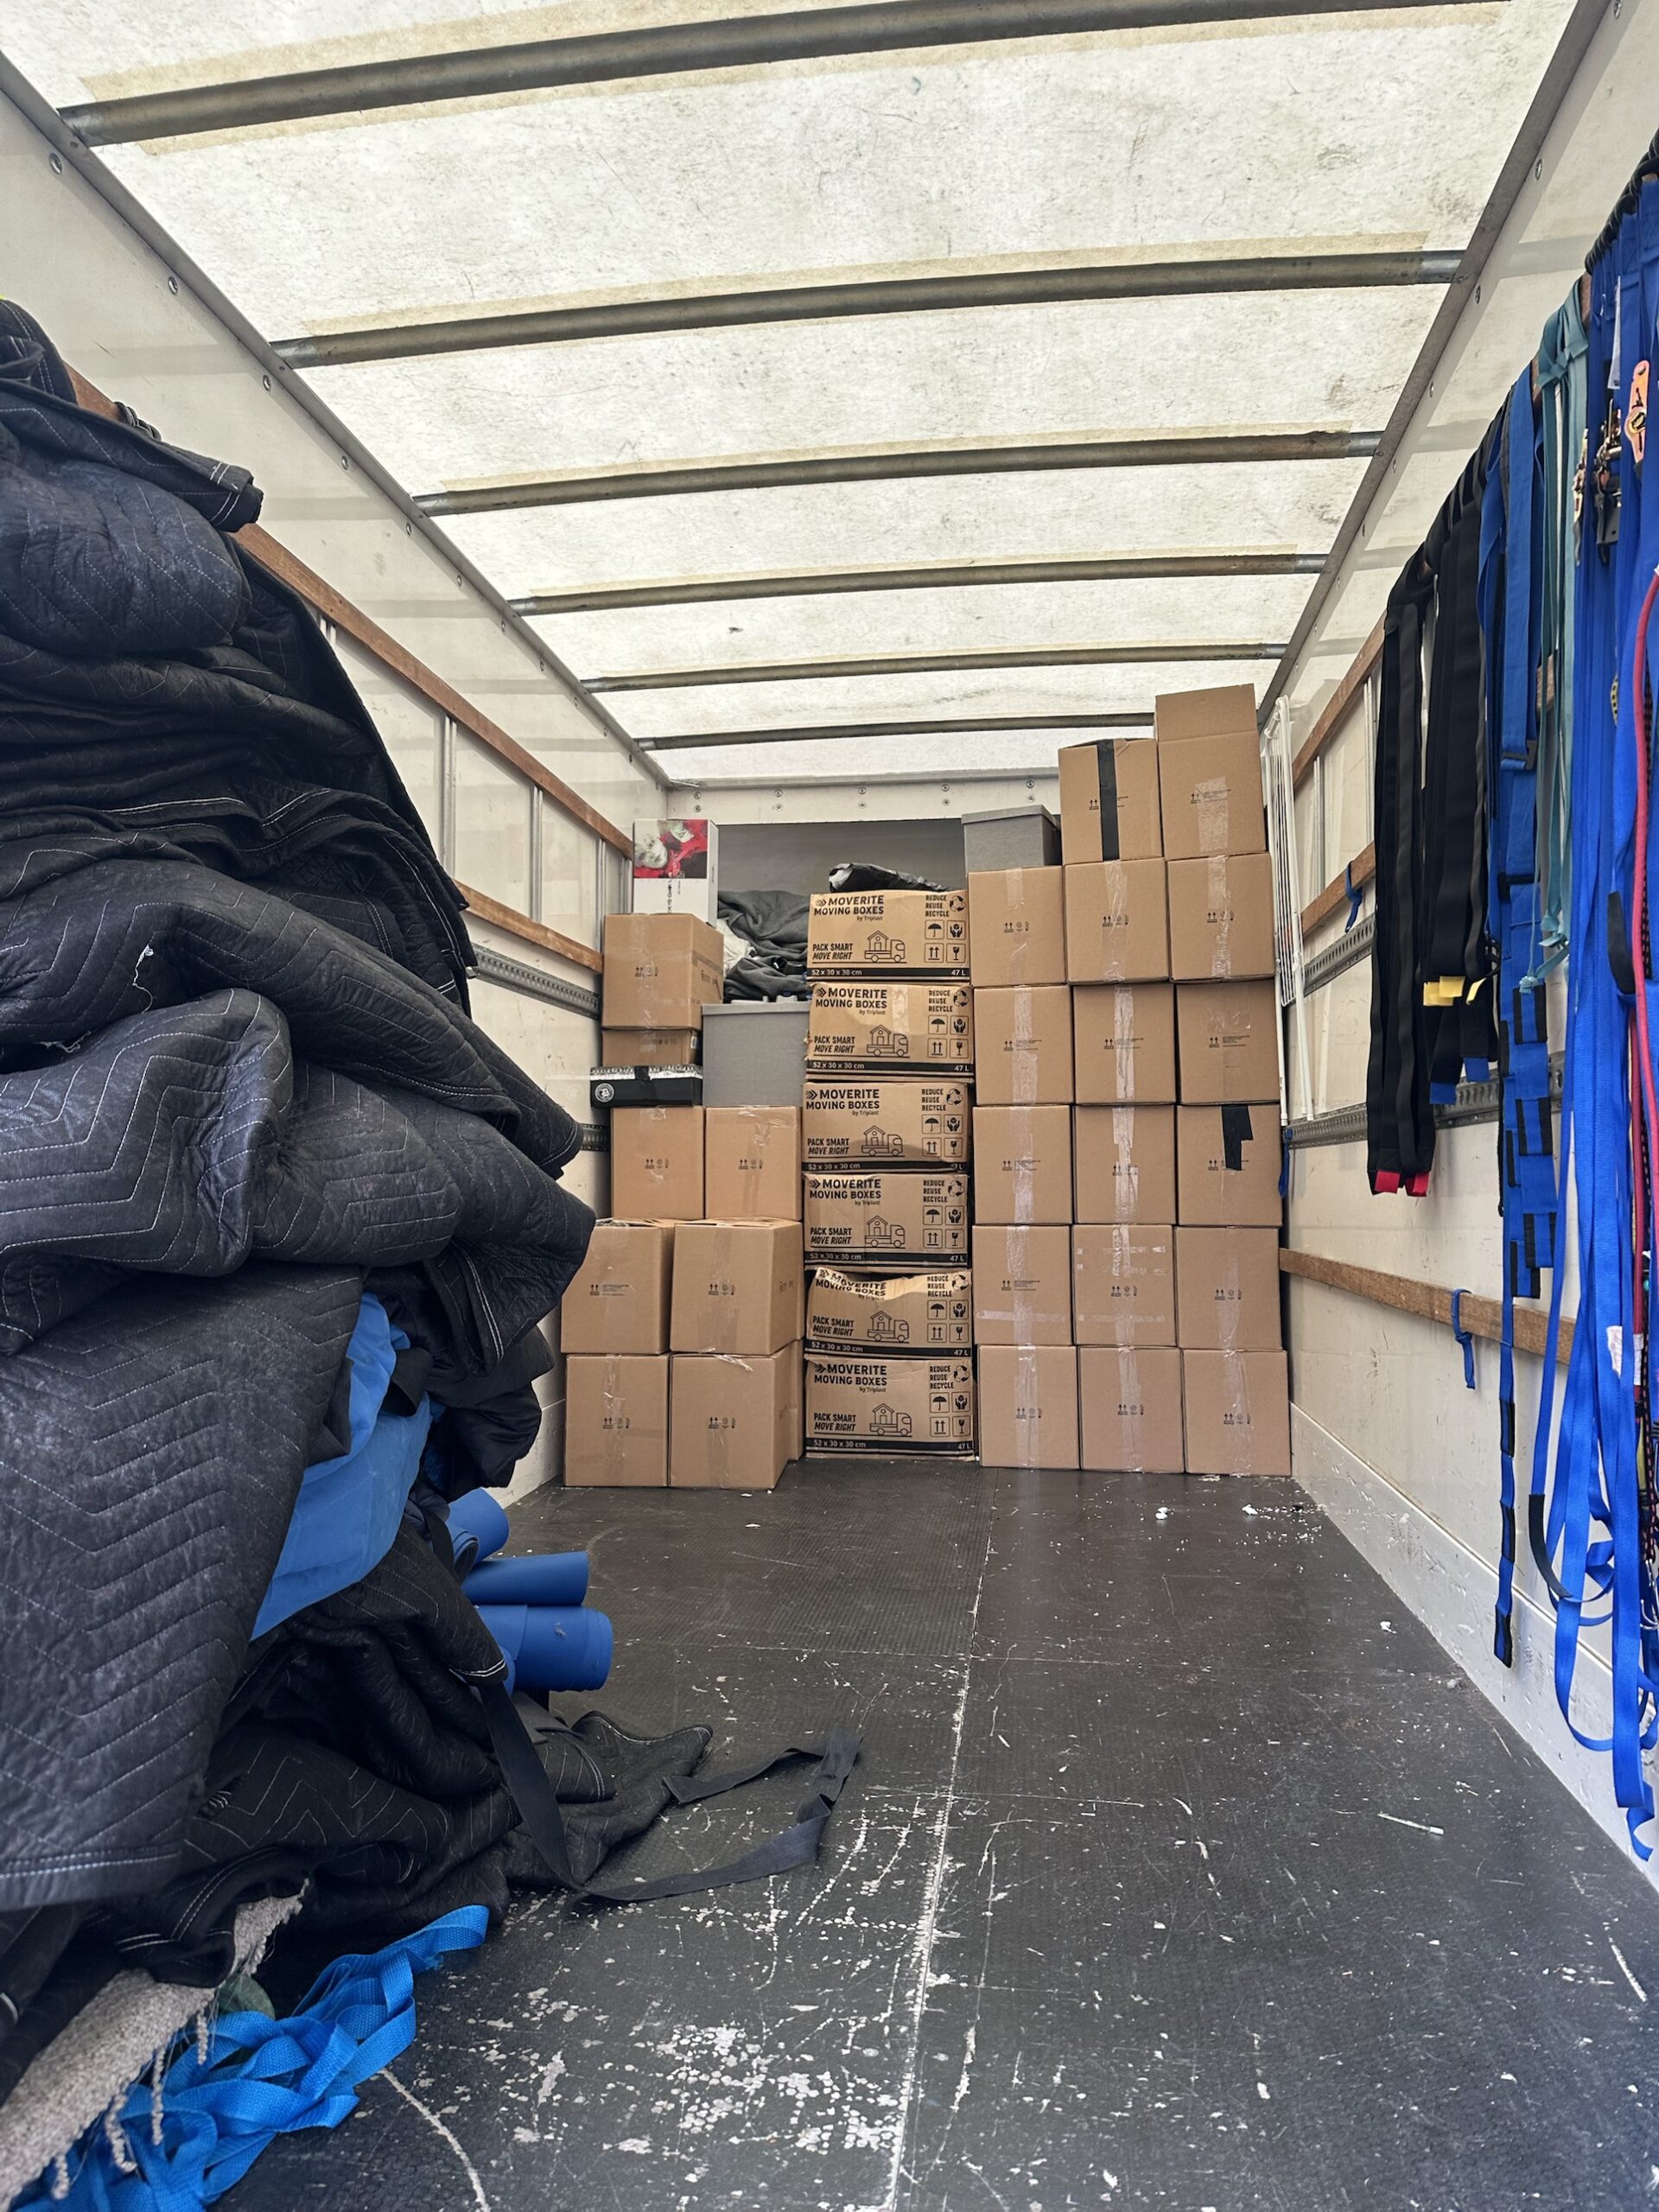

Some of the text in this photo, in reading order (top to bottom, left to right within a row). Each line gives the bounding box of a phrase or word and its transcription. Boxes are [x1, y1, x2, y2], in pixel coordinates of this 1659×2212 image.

[829, 895, 884, 906] MOVERITE
[814, 906, 884, 915] MOVING BOXES
[829, 988, 887, 999] MOVERITE
[816, 999, 887, 1008] MOVING BOXES
[820, 1090, 880, 1099] MOVERITE
[823, 1179, 880, 1188] MOVERITE
[831, 1273, 887, 1288] MOVERITE
[813, 1315, 855, 1327] PACK SMART
[813, 1325, 854, 1336] MOVE RIGHT
[828, 1364, 887, 1375] MOVERITE
[814, 1375, 887, 1386] MOVING BOXES
[814, 1422, 833, 1431] MOVE
